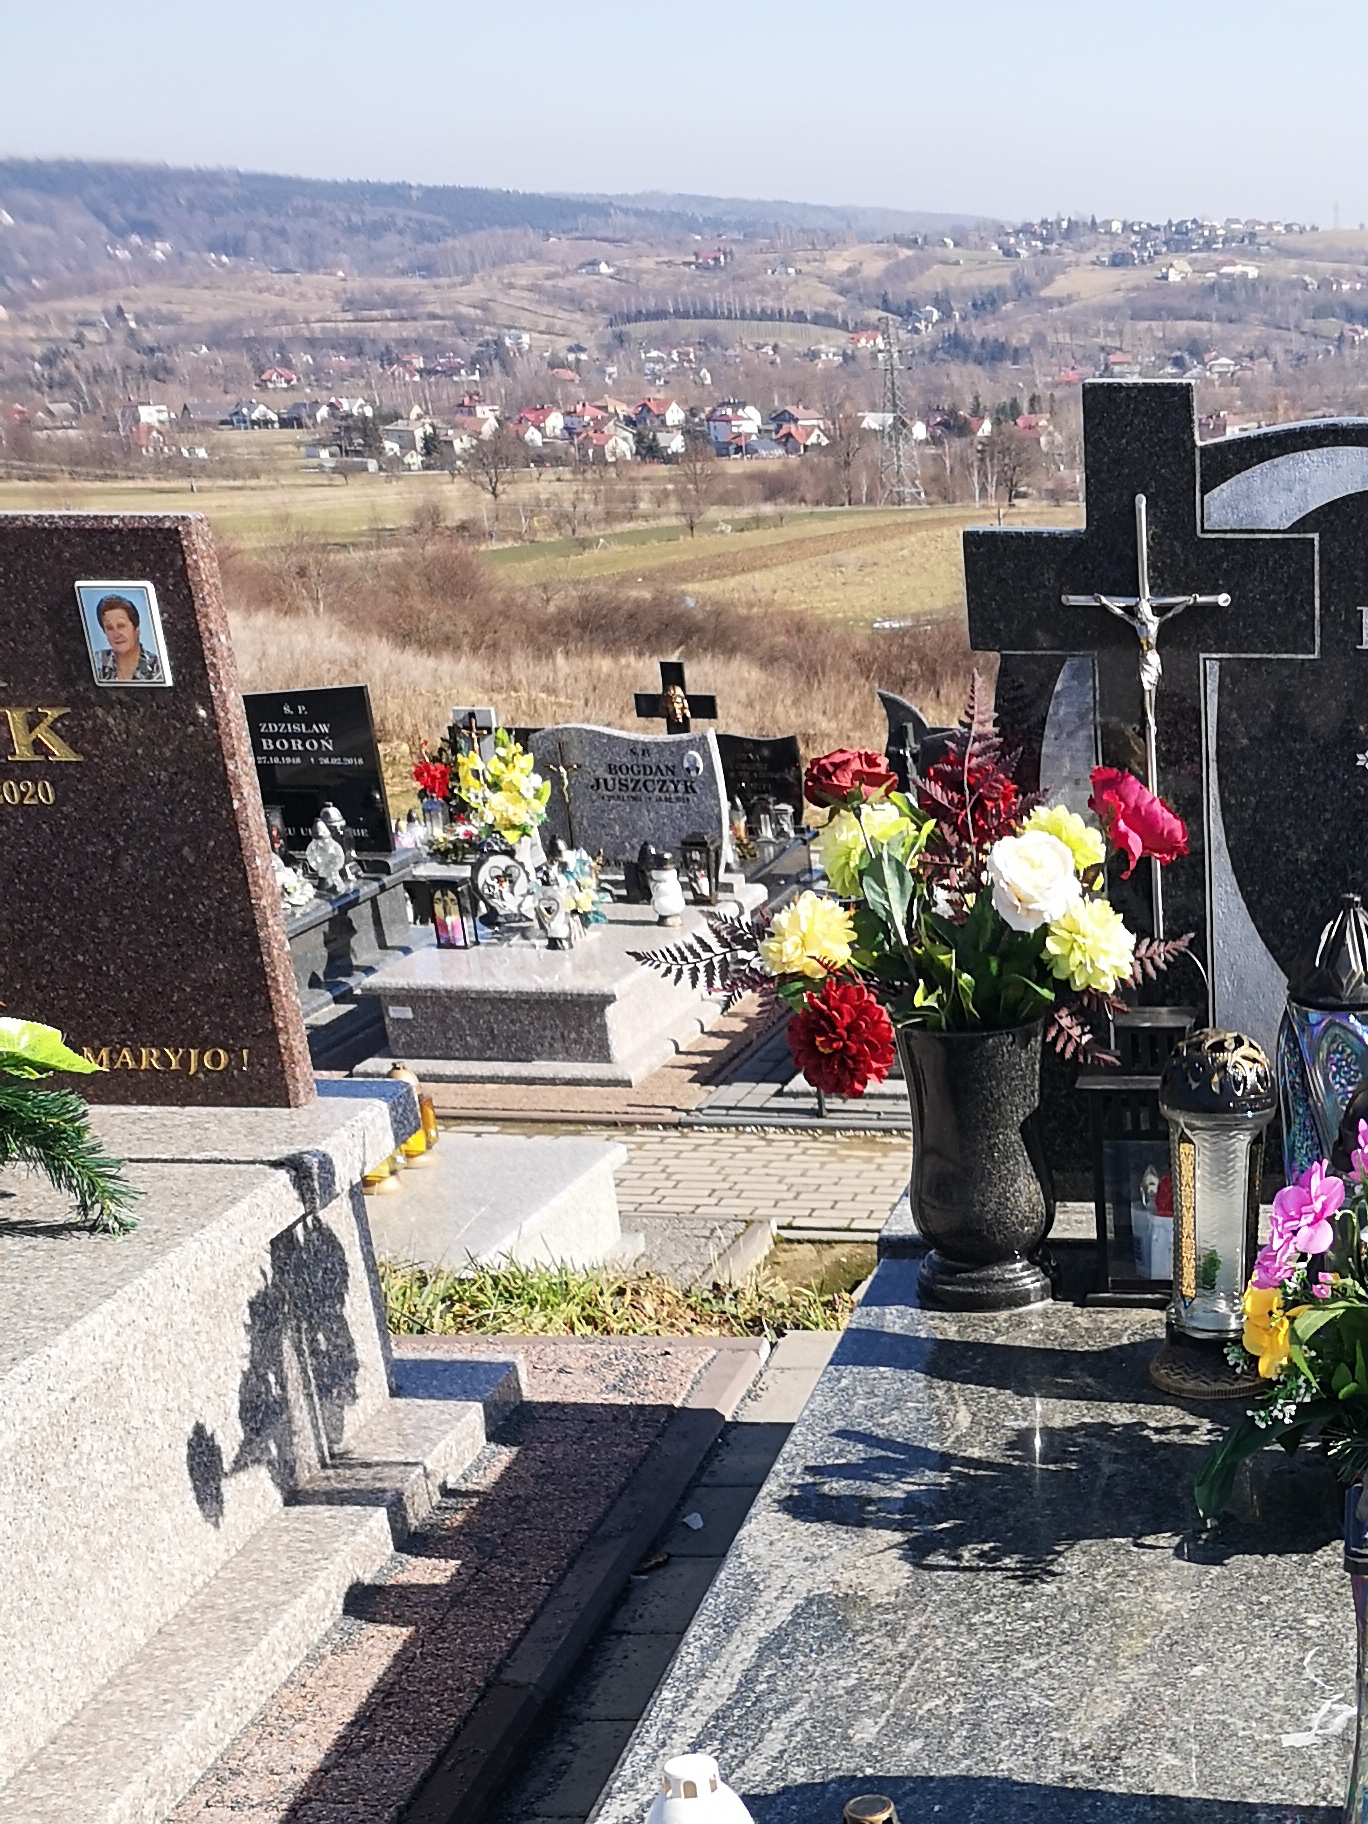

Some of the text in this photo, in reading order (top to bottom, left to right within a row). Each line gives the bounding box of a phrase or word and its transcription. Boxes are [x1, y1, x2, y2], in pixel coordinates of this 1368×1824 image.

[261, 736, 334, 752] BOROŃ
[606, 762, 677, 778] BOGDAN
[589, 777, 699, 795] JUSZCZYK
[82, 1046, 230, 1077] MARYJO
